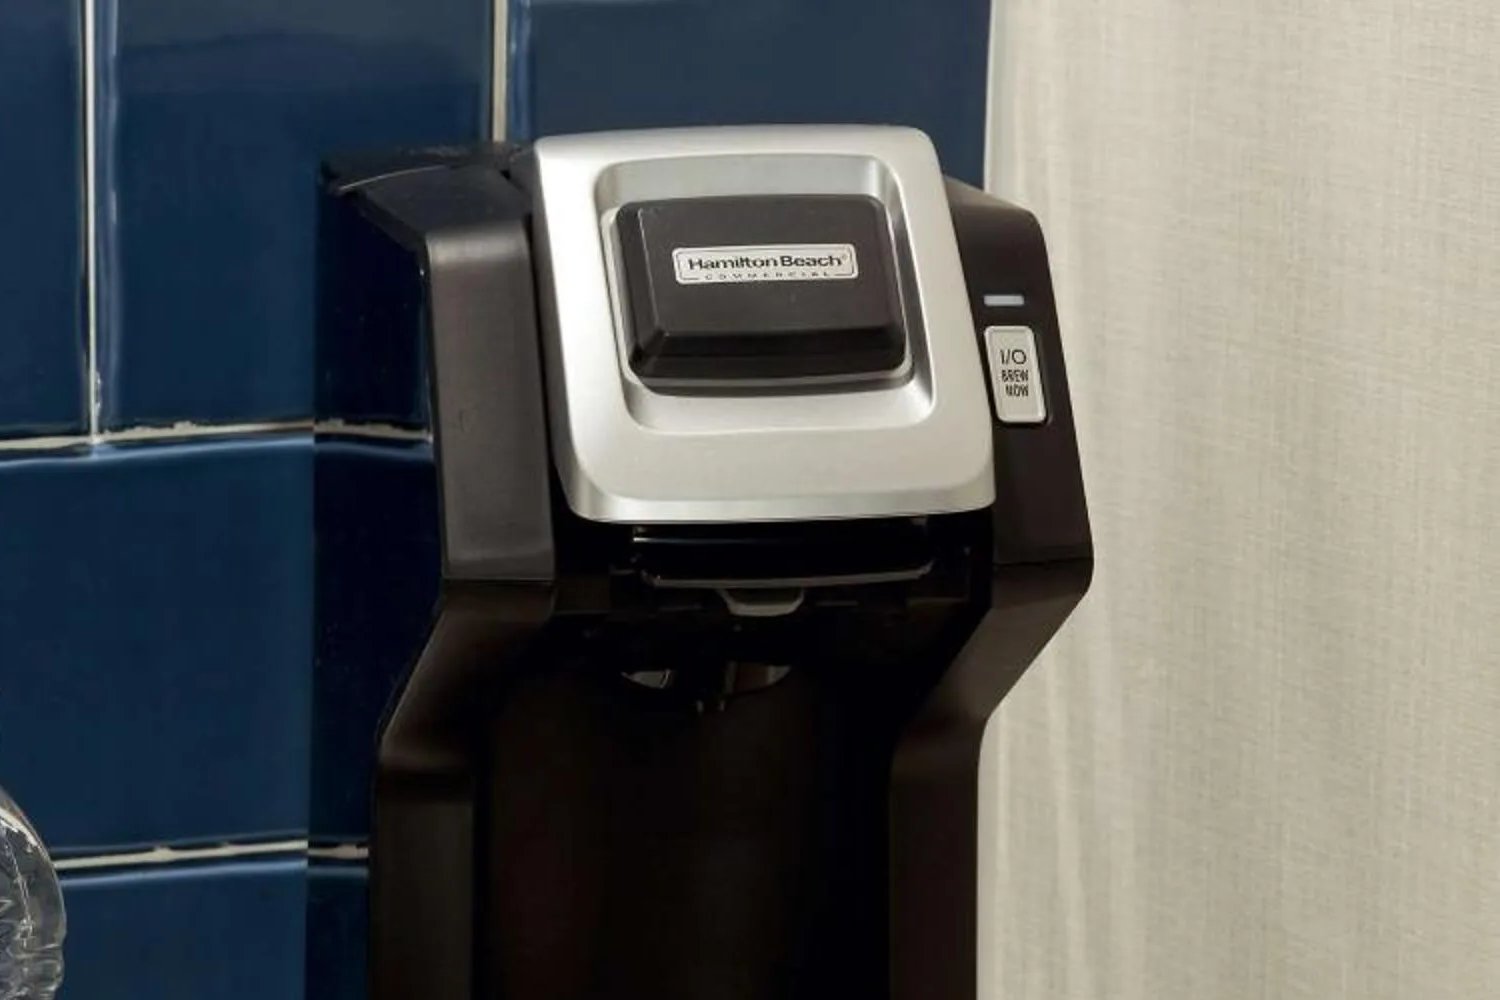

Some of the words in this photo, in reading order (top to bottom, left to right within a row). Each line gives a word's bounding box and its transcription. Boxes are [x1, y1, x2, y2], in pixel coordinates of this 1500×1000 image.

[688, 255, 778, 270] Hamilton
[1001, 369, 1029, 382] BREW
[1005, 384, 1029, 397] NOW
